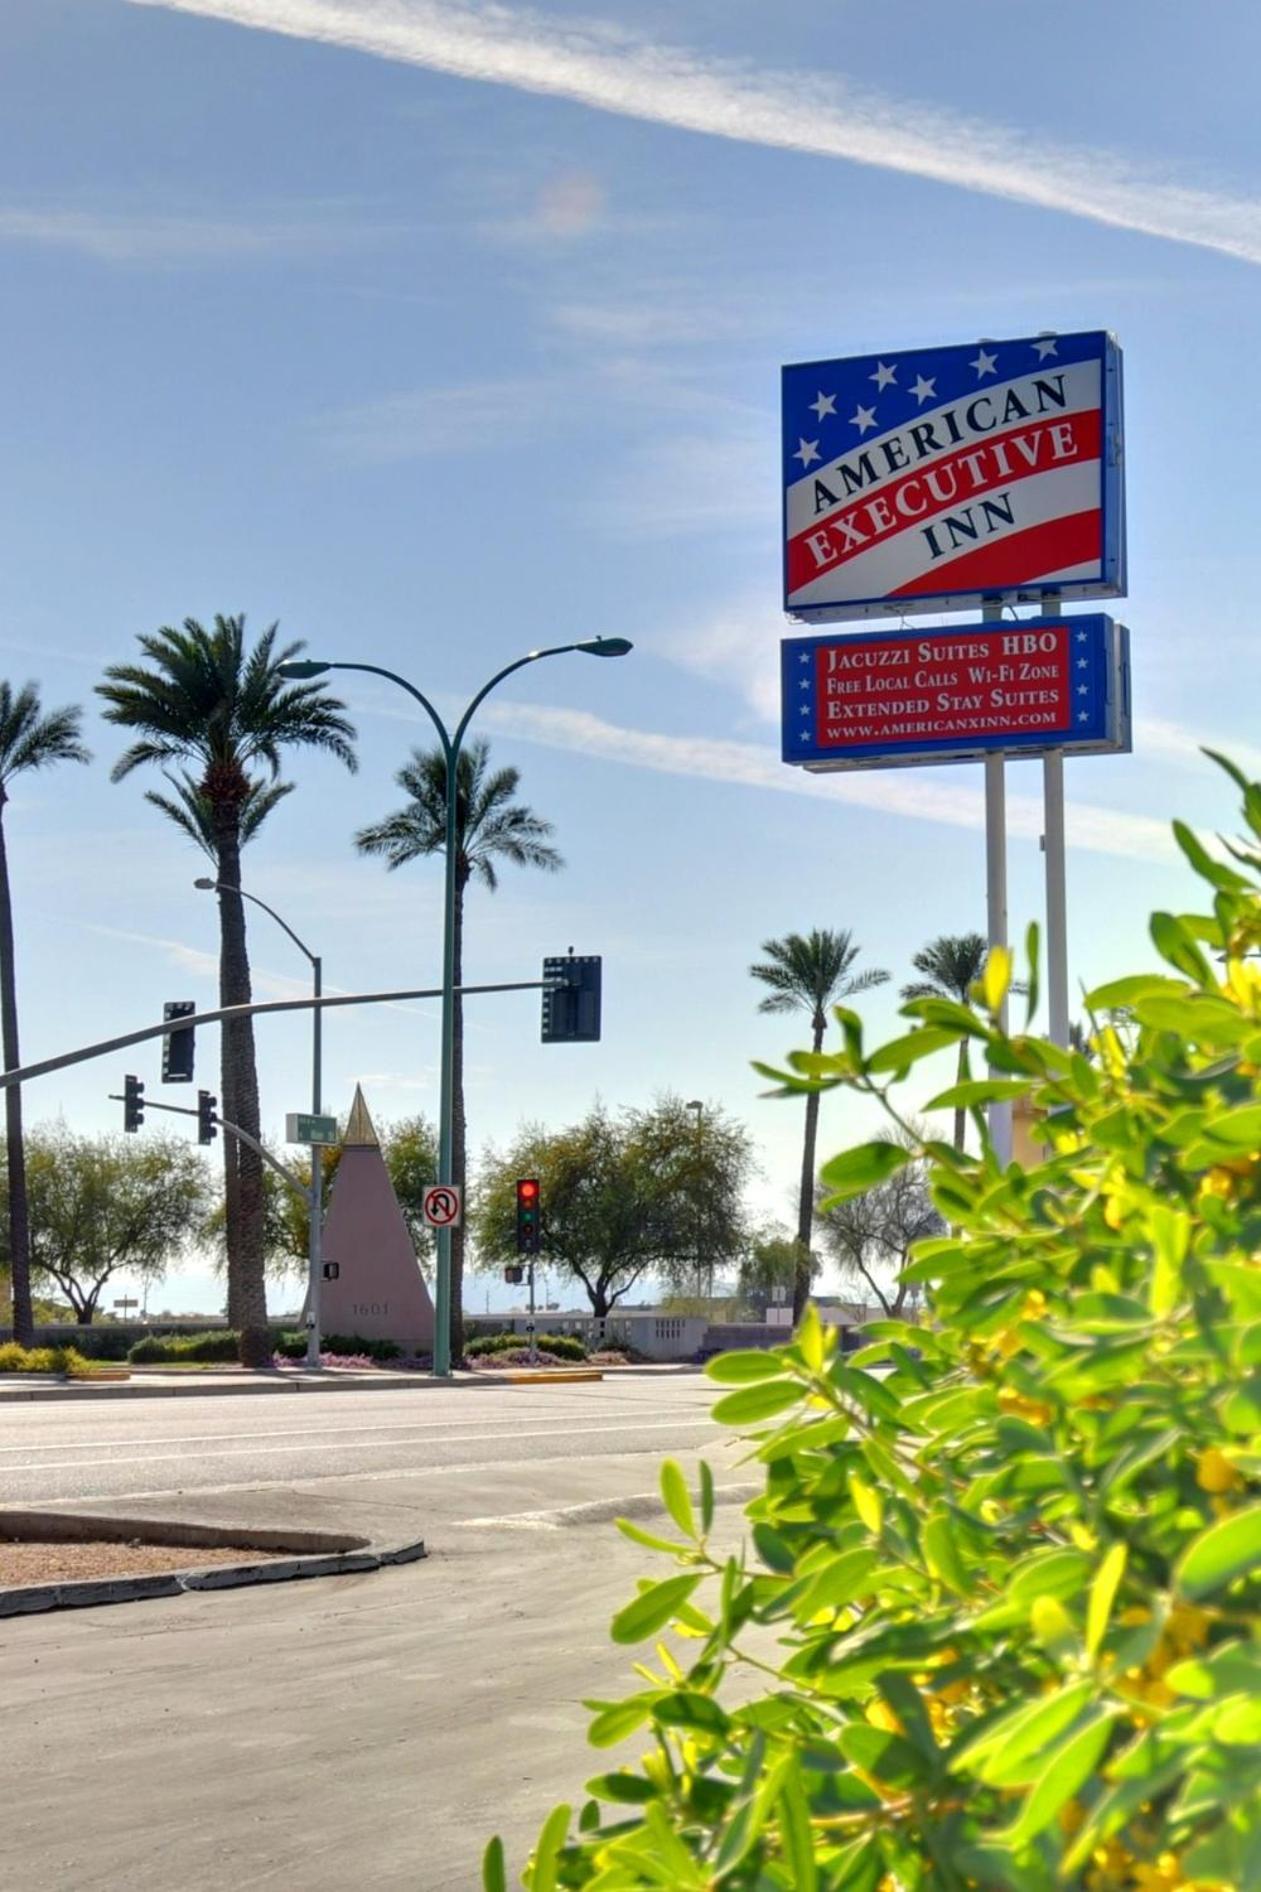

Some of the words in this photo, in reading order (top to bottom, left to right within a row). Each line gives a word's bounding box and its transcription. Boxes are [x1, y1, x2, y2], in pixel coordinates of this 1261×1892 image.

[813, 374, 1066, 515] AMERICAN
[804, 422, 1078, 569] EXECUTIVE
[920, 492, 1015, 560] INN
[827, 650, 910, 673] JACUZZI
[918, 642, 989, 662] SUITES
[1002, 633, 1057, 655] HBO
[827, 678, 861, 695] FREE
[866, 675, 910, 692] LOCAL
[914, 670, 958, 688] CALLS
[1019, 662, 1059, 680] ZONE
[827, 699, 929, 720] EXTENDED
[937, 693, 983, 711] STAY
[990, 688, 1060, 707] SUITES
